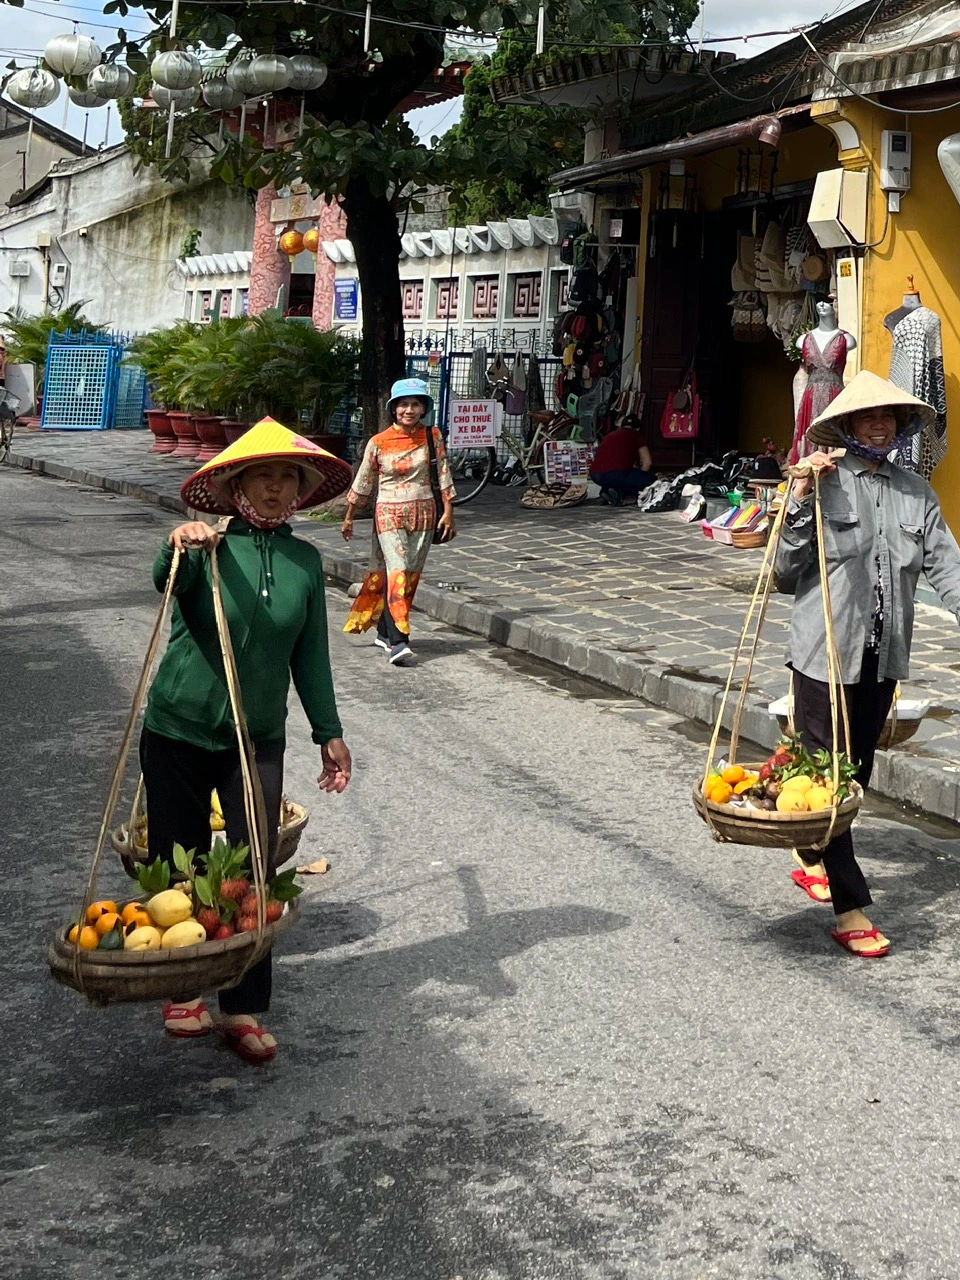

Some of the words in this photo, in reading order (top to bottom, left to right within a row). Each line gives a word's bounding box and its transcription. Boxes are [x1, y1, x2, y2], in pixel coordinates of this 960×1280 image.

[458, 405, 470, 414] TẠI
[472, 413, 491, 423] THUÊ
[458, 425, 469, 433] XE
